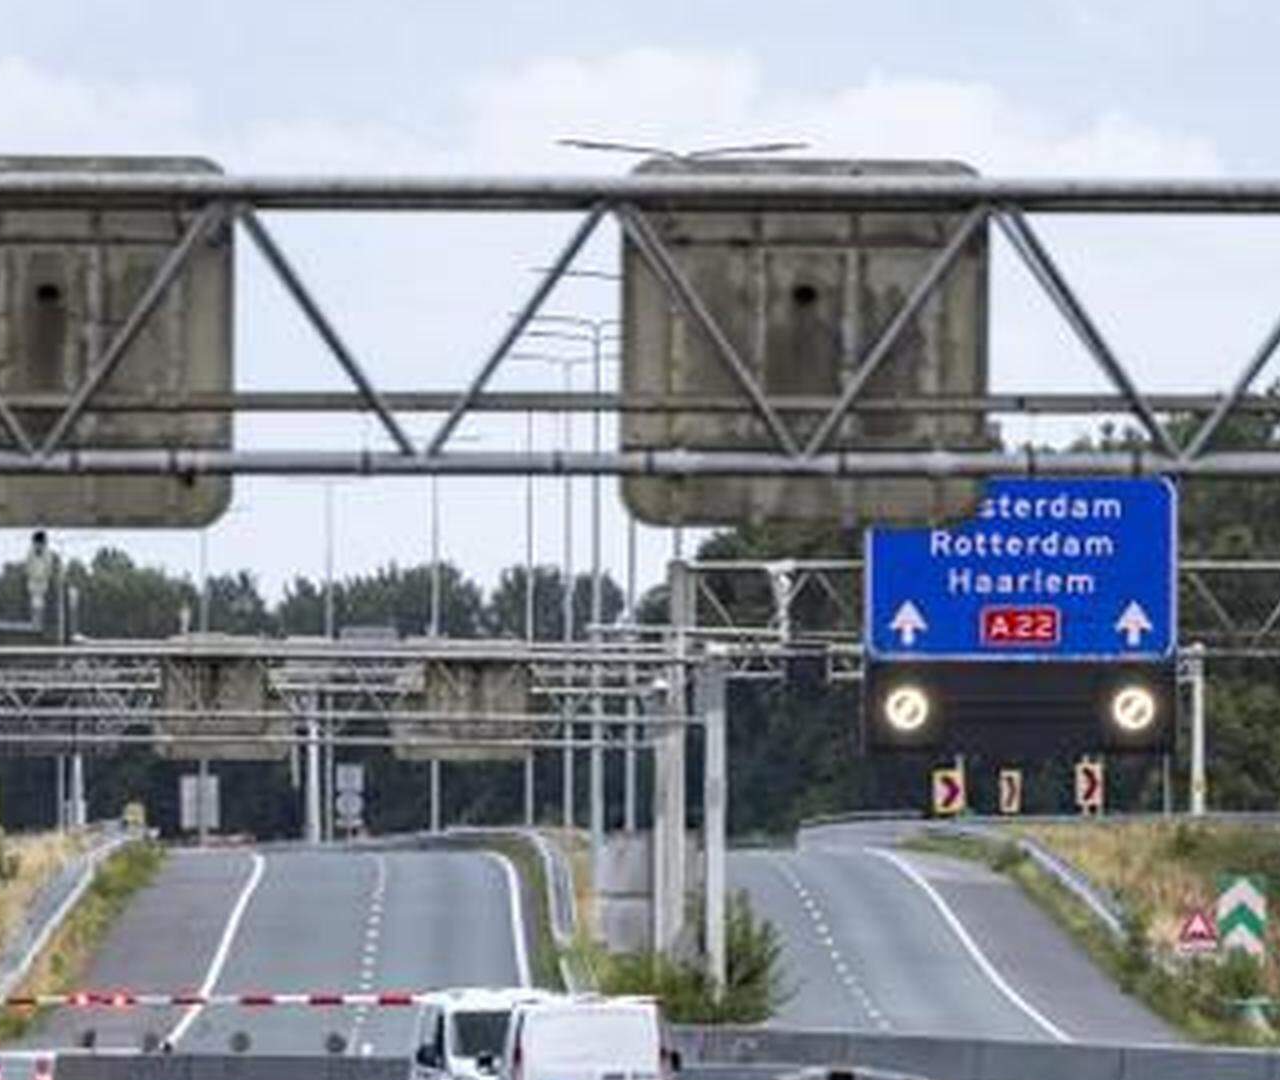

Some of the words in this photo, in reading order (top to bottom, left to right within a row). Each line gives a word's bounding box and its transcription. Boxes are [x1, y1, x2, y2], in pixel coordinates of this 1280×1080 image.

[977, 493, 1122, 519] sterdam
[930, 530, 1115, 557] Rotterdam
[948, 567, 1095, 594] Haarlem
